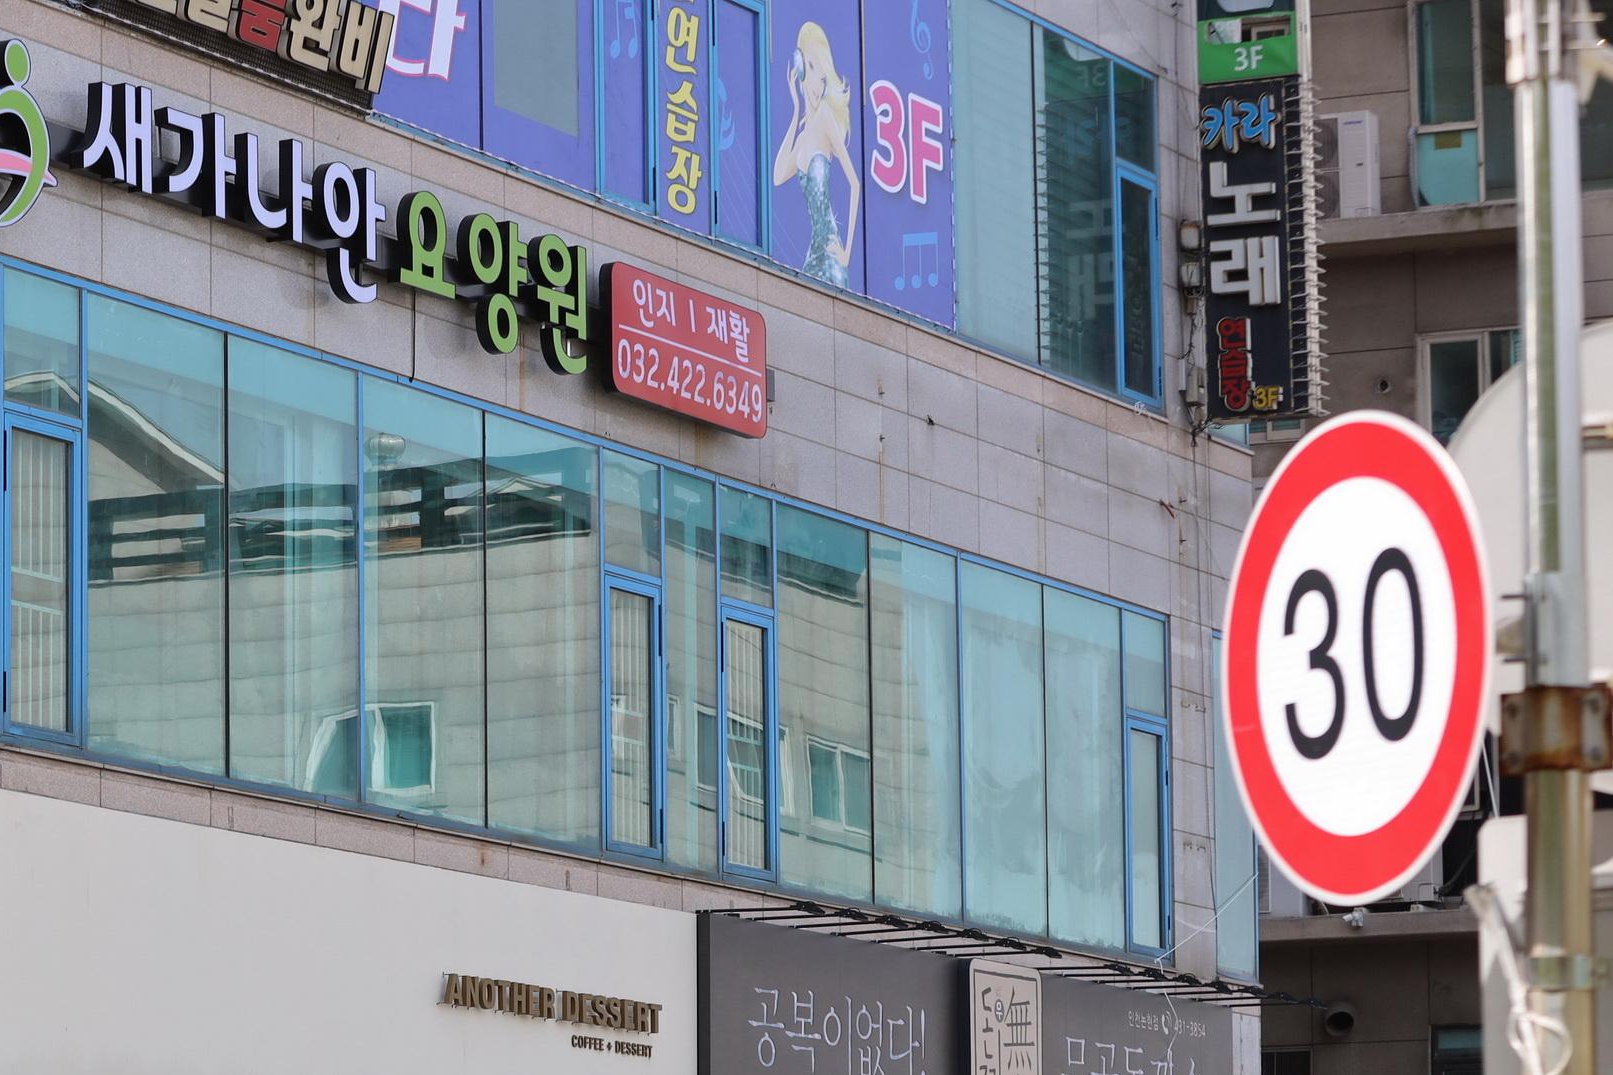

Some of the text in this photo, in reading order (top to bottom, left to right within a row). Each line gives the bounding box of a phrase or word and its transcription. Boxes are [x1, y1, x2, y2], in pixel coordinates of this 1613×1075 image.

[1234, 45, 1263, 72] 3F
[666, 5, 702, 214] 연습장
[870, 80, 944, 205] 3F
[1202, 94, 1279, 152] 카라
[83, 82, 587, 376] 새가나안 요양원
[632, 278, 751, 363] 인지 재활
[617, 338, 763, 424] 032.422.6349
[1216, 316, 1253, 411] 연습장
[1253, 385, 1283, 411] 3F
[1283, 546, 1424, 760] 30
[444, 973, 662, 1034] ANOTHER DESSERT
[571, 1034, 605, 1051] COFFEE
[615, 1040, 653, 1059] DESSERT
